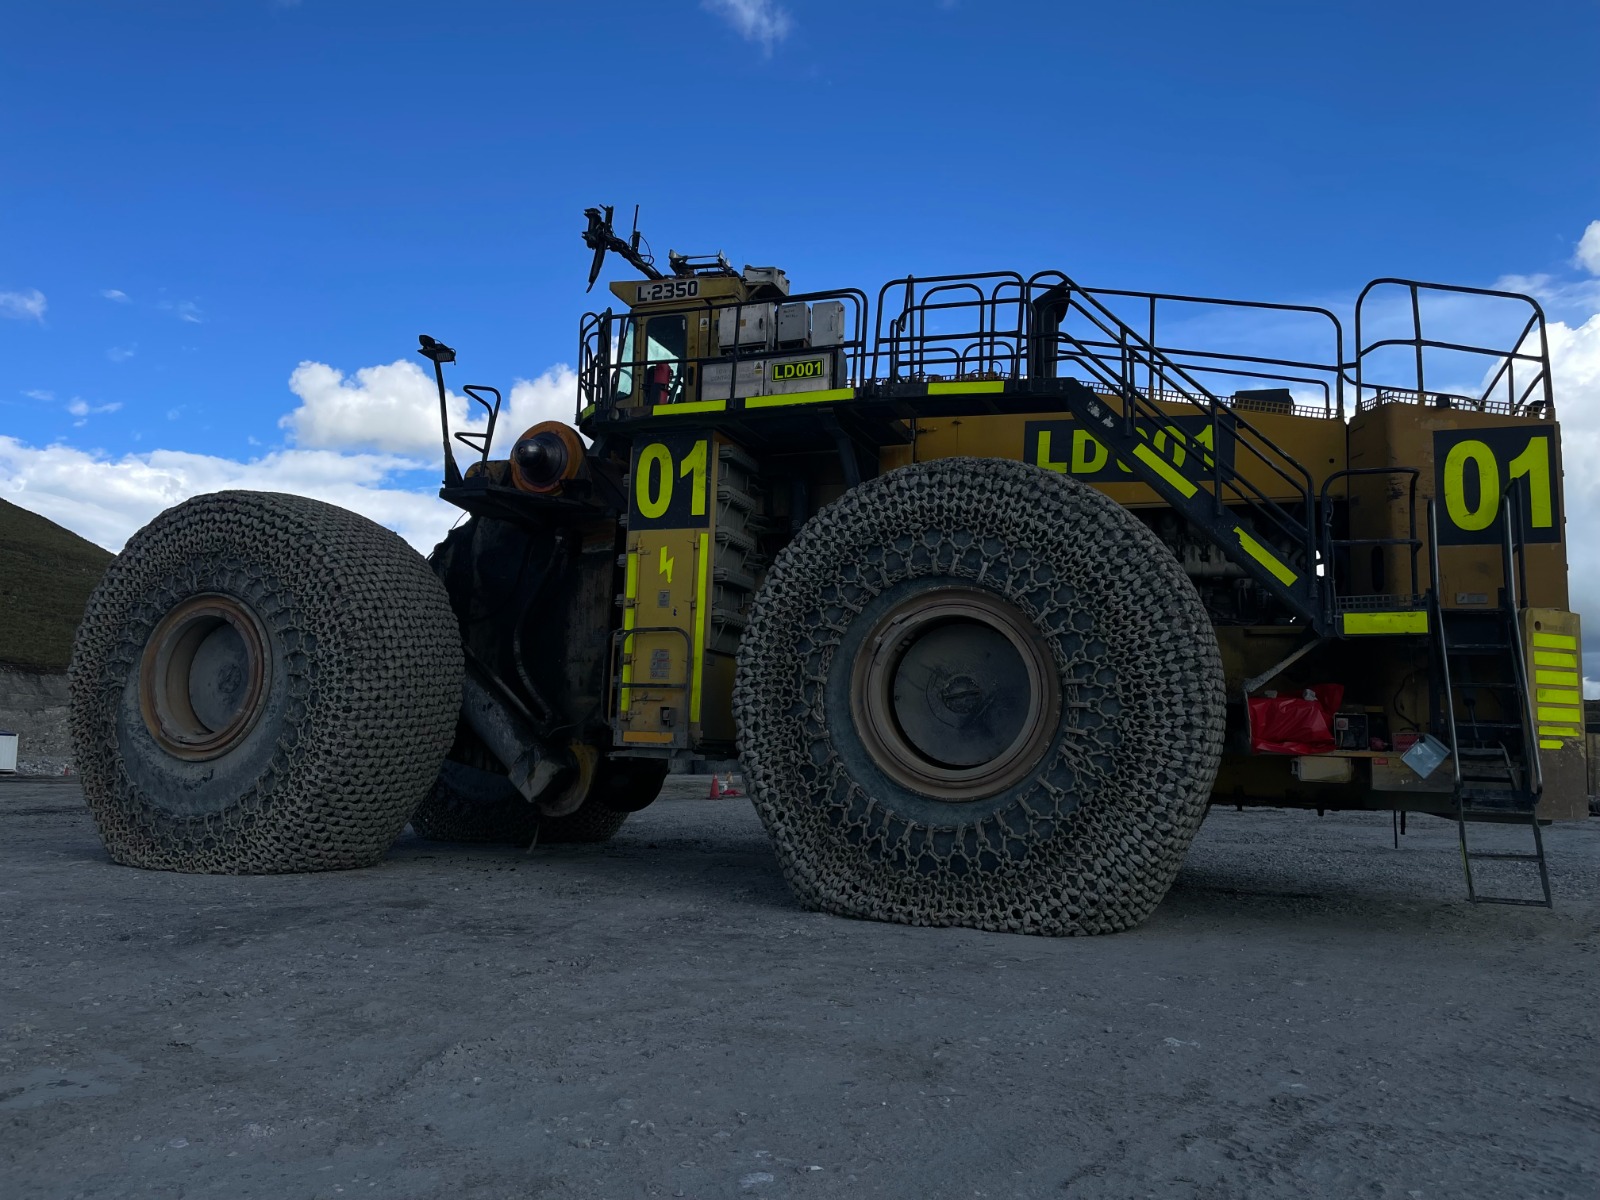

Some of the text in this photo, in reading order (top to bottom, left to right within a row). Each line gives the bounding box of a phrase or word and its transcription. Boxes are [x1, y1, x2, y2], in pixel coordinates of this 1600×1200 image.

[774, 361, 823, 380] LD001
[636, 440, 708, 519] 01
[1444, 436, 1553, 531] 01
